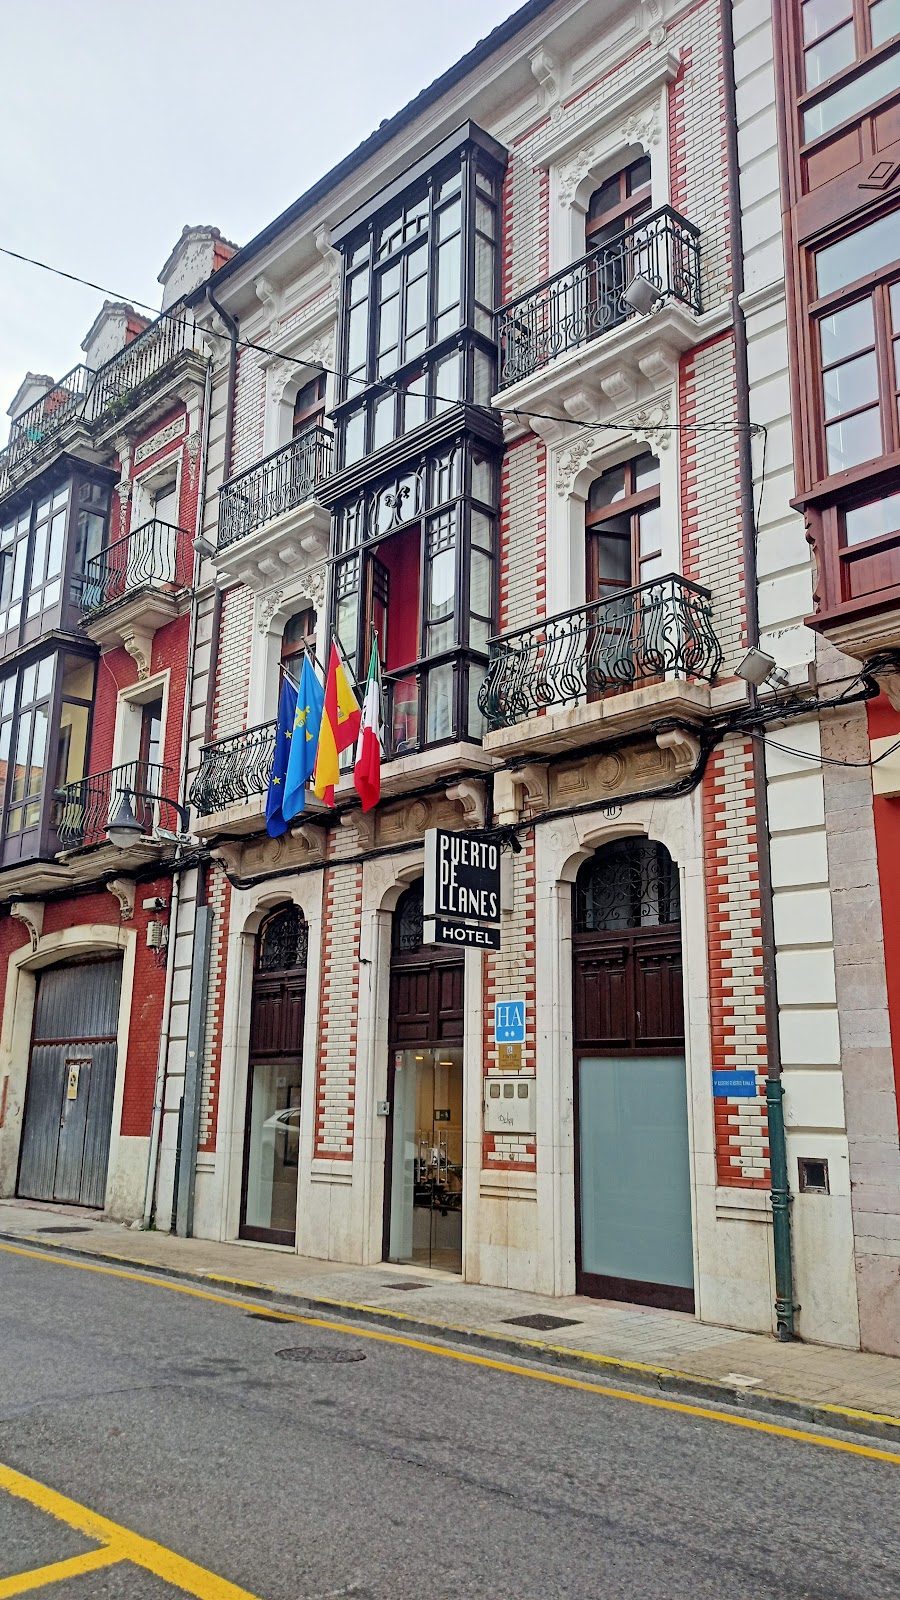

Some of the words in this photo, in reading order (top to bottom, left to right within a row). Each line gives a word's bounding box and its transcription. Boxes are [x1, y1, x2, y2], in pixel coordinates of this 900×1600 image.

[440, 835, 497, 870] PUERTO
[441, 859, 458, 887] DE
[440, 884, 497, 917] LLANES
[442, 926, 493, 944] HOTEL
[497, 1006, 523, 1027] HA
